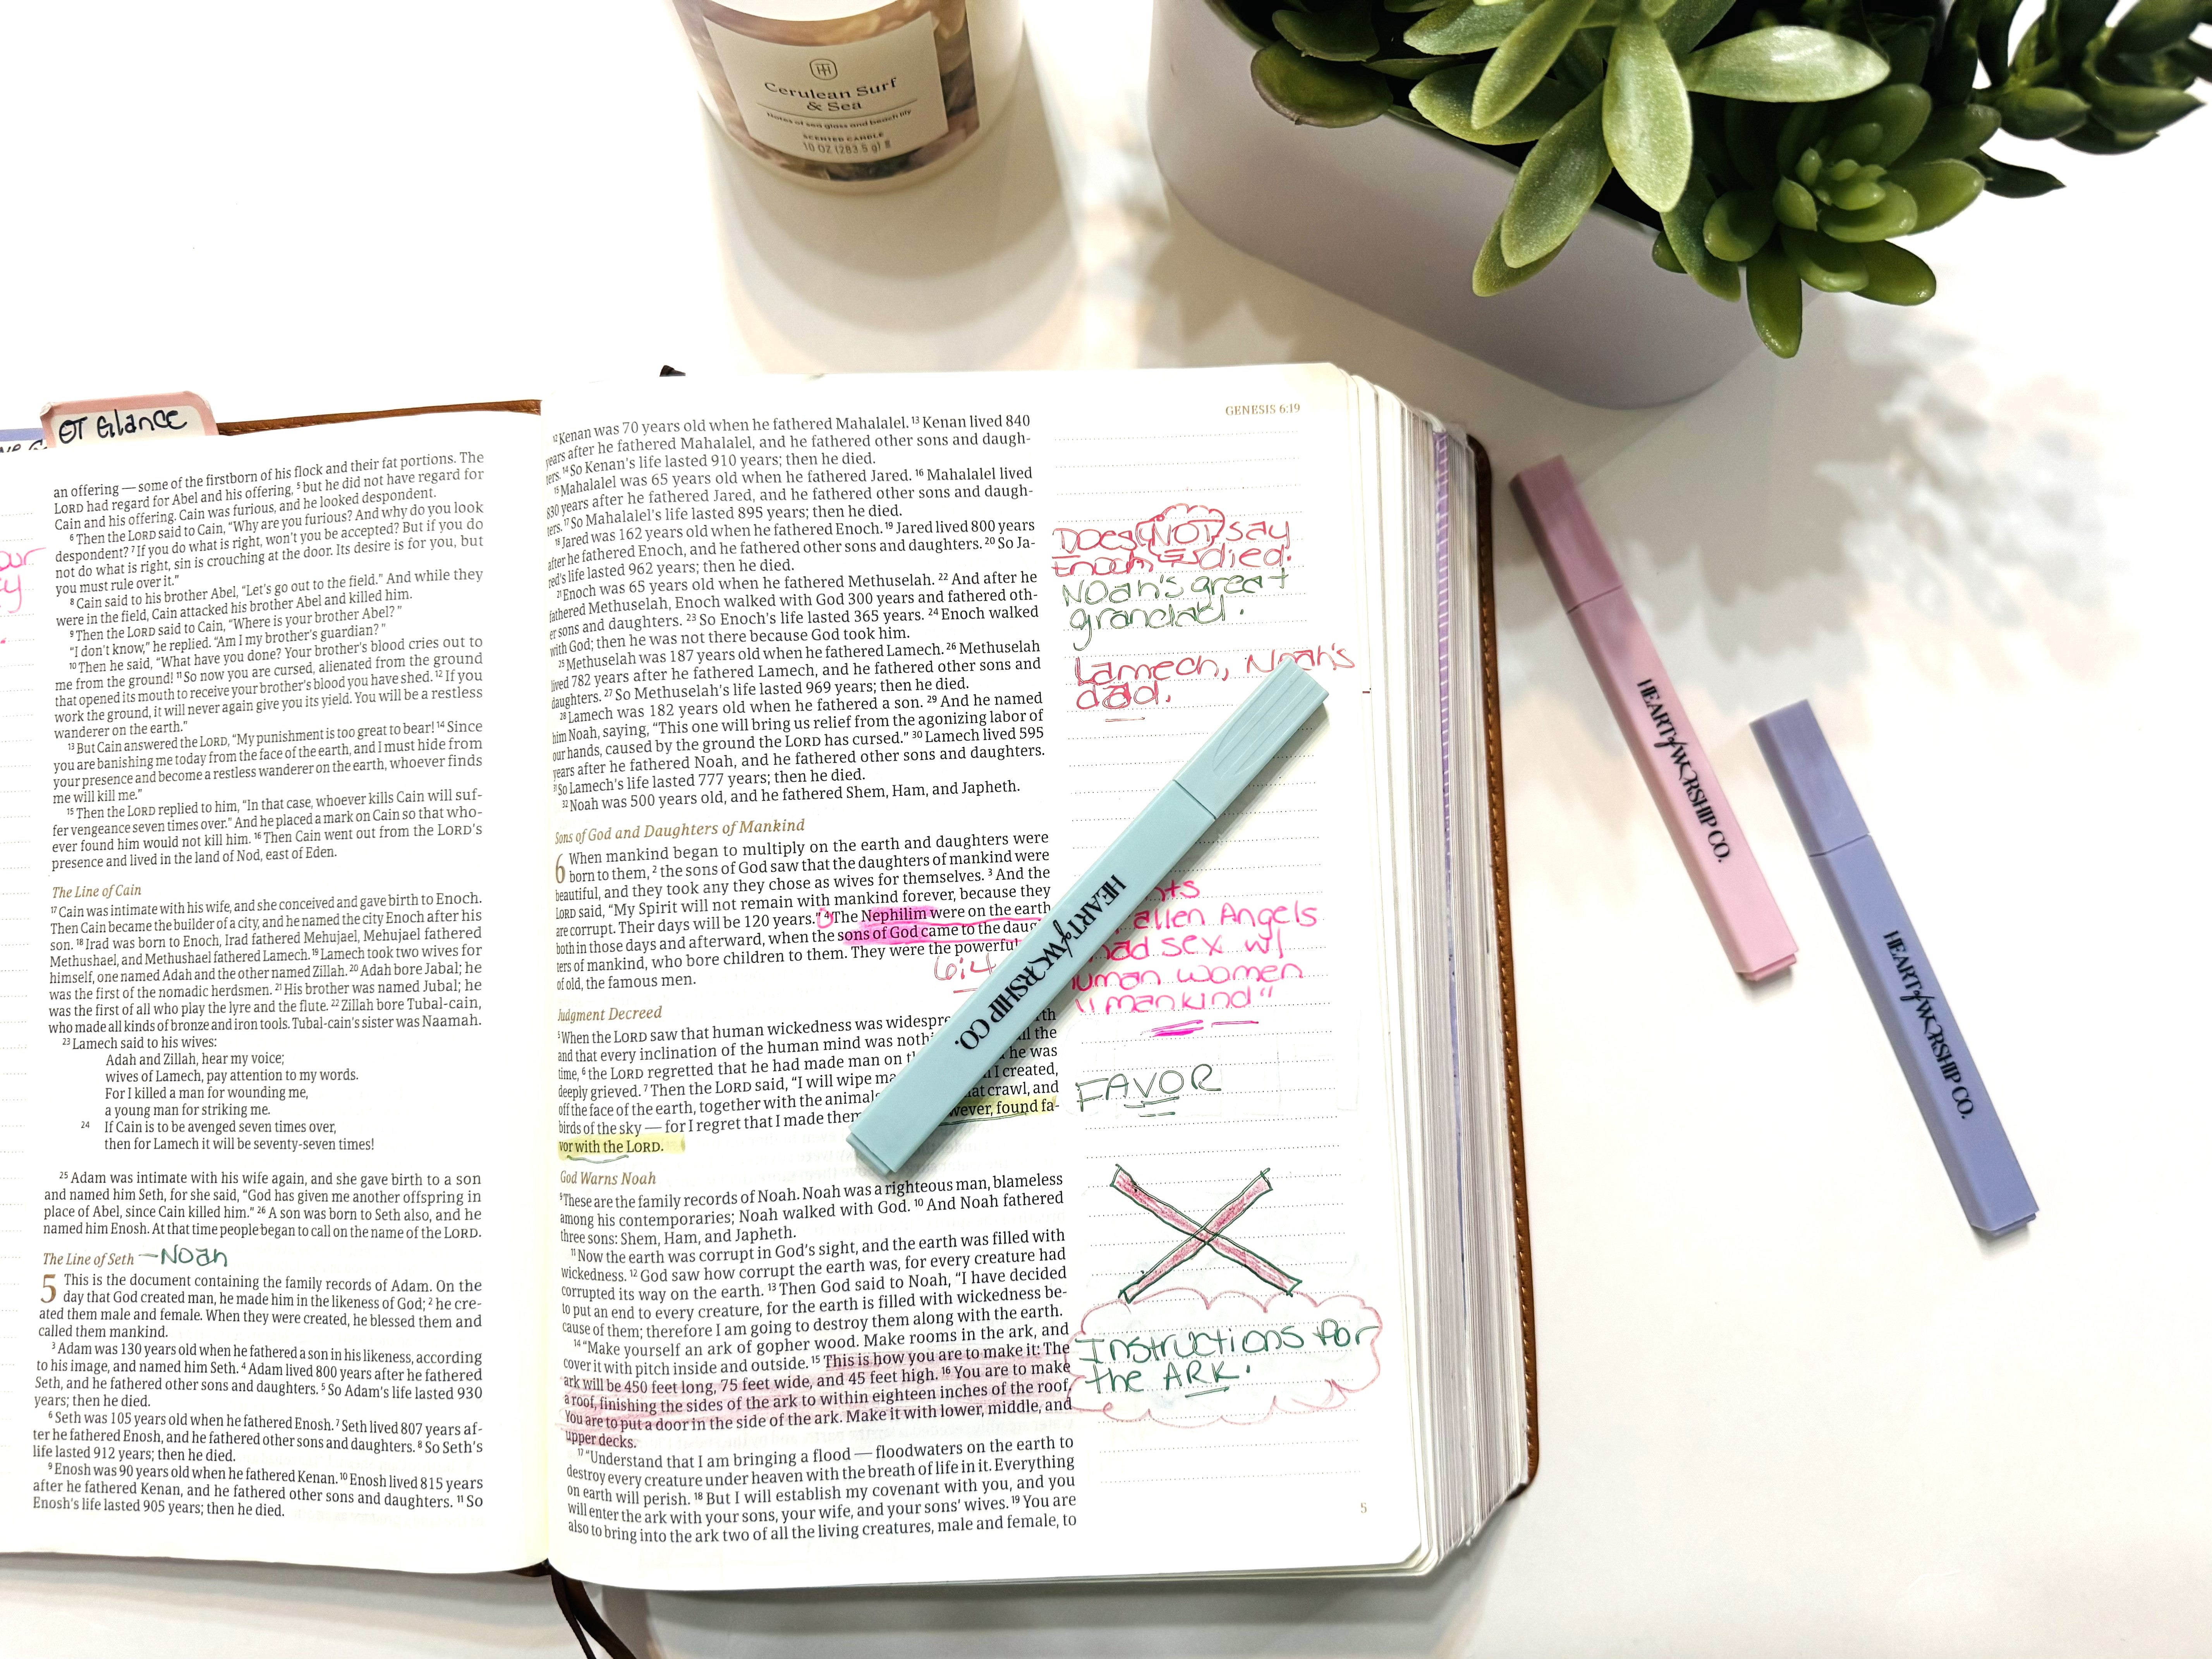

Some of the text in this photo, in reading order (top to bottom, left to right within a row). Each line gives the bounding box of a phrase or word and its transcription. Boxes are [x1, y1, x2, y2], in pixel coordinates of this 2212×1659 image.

[764, 77, 897, 99] Cerulean Surf
[807, 101, 862, 112] & Sea
[767, 112, 793, 124] Notes
[806, 121, 823, 129] sea
[870, 114, 898, 126] beach
[900, 110, 911, 118] lily
[803, 142, 815, 152] 10
[818, 144, 831, 153] OZ
[847, 132, 884, 141] CANDLE
[1225, 403, 1300, 416] GENESIS 6:19
[55, 488, 436, 530] Cain and his offering. Cain was furious, and he looked despondent.
[1152, 519, 1223, 547] NOT
[1226, 521, 1290, 549] say
[1199, 543, 1291, 570] died.
[548, 558, 794, 589] red's life lasted 962 years; then he died.
[55, 585, 77, 597] you
[79, 581, 108, 593] must
[111, 578, 134, 591] rule
[136, 578, 161, 589] over
[1191, 567, 1289, 611] great
[1075, 655, 1229, 686] Lamech,
[1637, 678, 1730, 863] HEART of WORSHIP CO.
[555, 818, 805, 845] Sons of God and Daughters of Mankind
[555, 853, 566, 884] 6
[53, 884, 142, 899] The Line of Cain
[1121, 900, 1317, 940] allen Angels
[1161, 934, 1223, 957] sex
[955, 874, 1127, 1050] HEART of WORSHIP CO.
[557, 975, 696, 991] of old, the famous men.
[1177, 963, 1303, 984] women
[557, 1005, 662, 1024] Judgment Decreed
[1883, 930, 1974, 1119] HEART of WORSHIP CO.
[1075, 1063, 1222, 1113] FAVOR
[105, 1137, 374, 1152] then for Lamech it will be seventy-seven times!
[559, 1140, 664, 1153] vor with the LORD.
[560, 1170, 656, 1185] God Warns Noah
[561, 1225, 796, 1247] three sons: Shem, Ham, and Japheth.
[43, 1252, 134, 1268] The Line of Seth
[40, 1274, 57, 1304] 5
[38, 1324, 168, 1338] called them mankind.
[1074, 1325, 1305, 1364] Instructions
[1084, 1364, 1144, 1394] the
[565, 1430, 637, 1449] upper decks.
[33, 1496, 284, 1517] Enosh's life lasted 905 years; then he died.
[1360, 1503, 1367, 1513] 5
